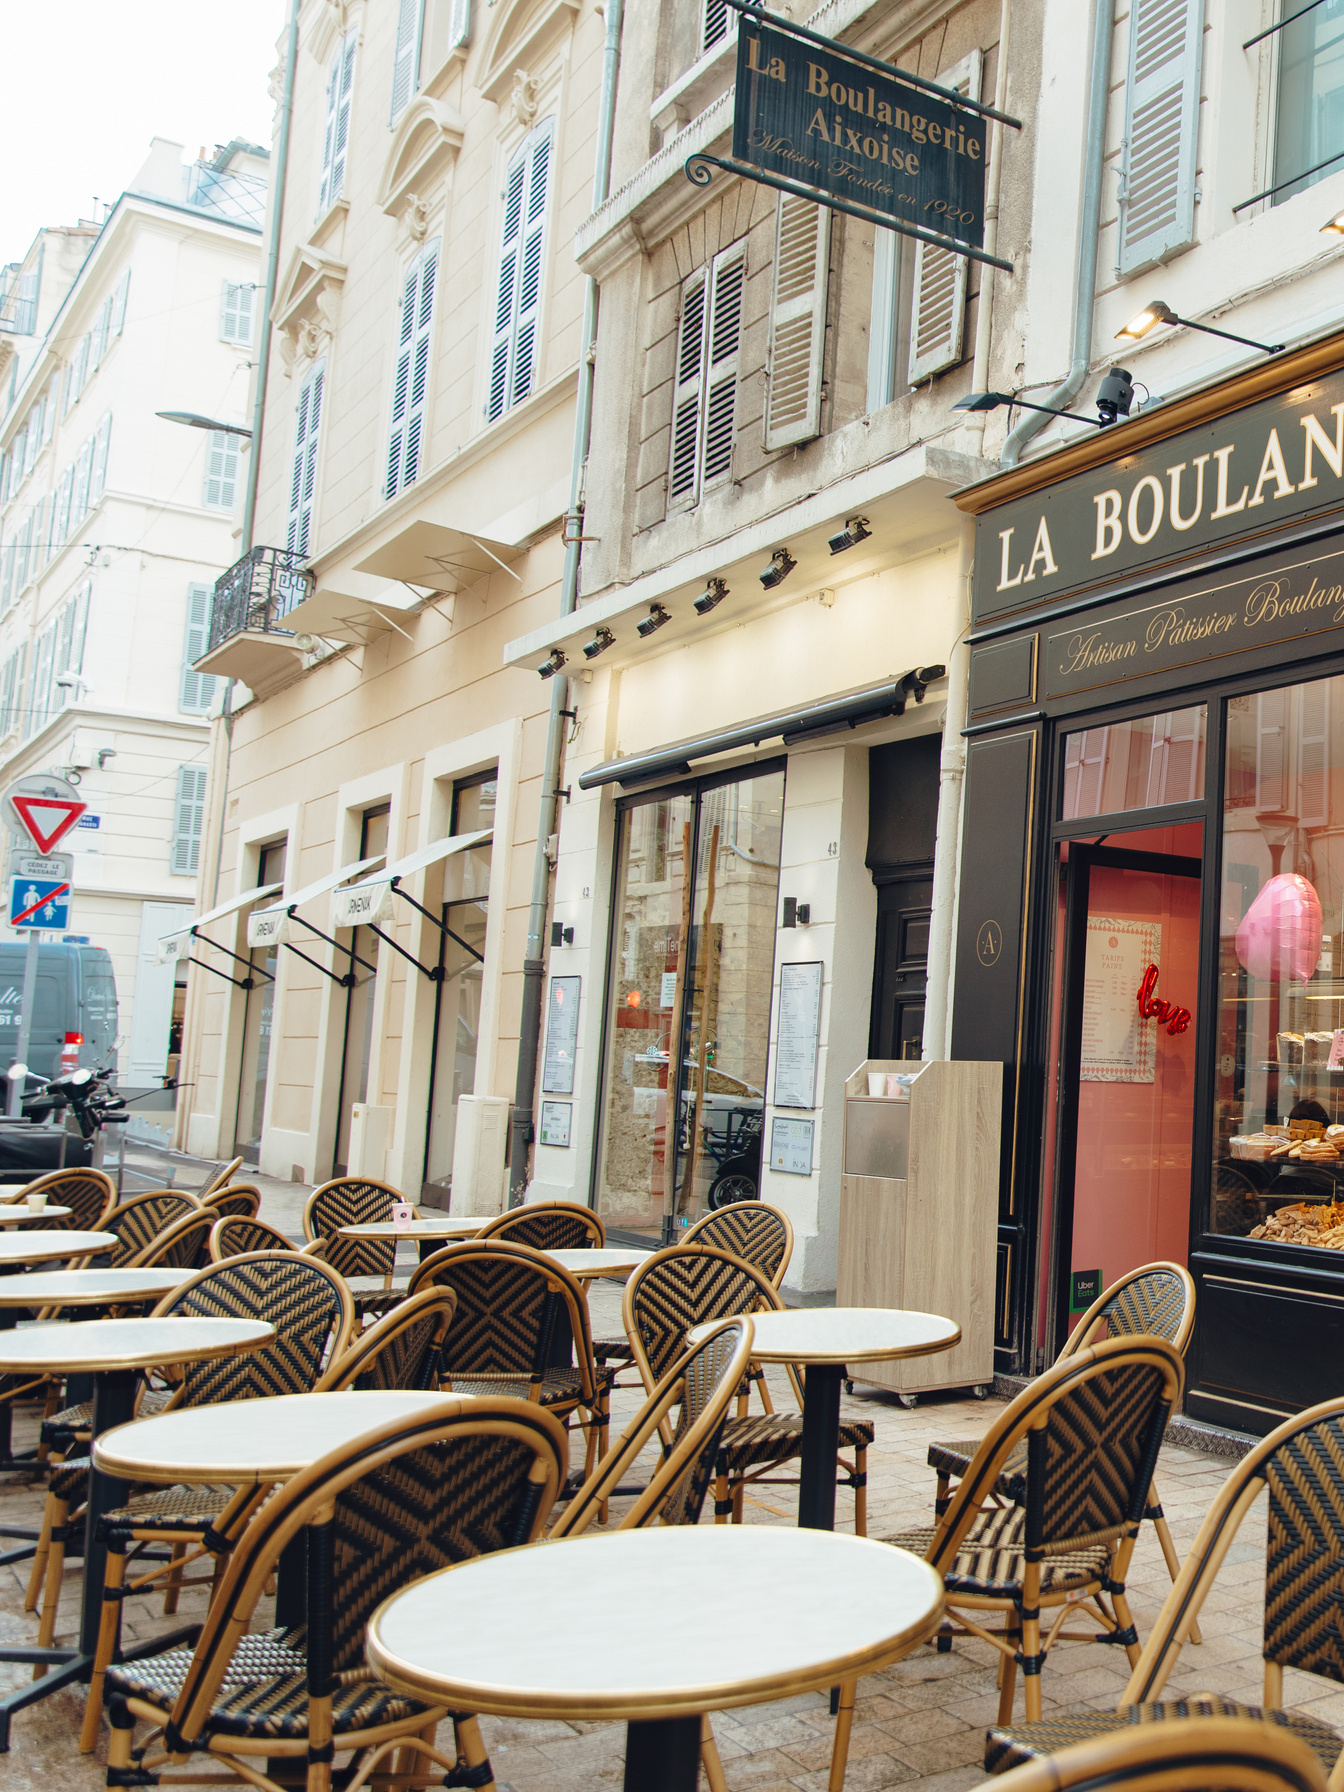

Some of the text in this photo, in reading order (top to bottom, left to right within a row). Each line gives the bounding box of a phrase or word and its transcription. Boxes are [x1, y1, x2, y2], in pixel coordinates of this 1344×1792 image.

[745, 36, 981, 160] La Boulangerie
[805, 107, 920, 176] Aixoise
[747, 127, 975, 226] Maison Fondée en 1920
[996, 516, 1059, 592] LA
[1059, 632, 1137, 674] Artisan
[1145, 607, 1237, 652] Pâtissier
[28, 868, 58, 876] PASSAGE
[1101, 954, 1124, 962] TARIFS
